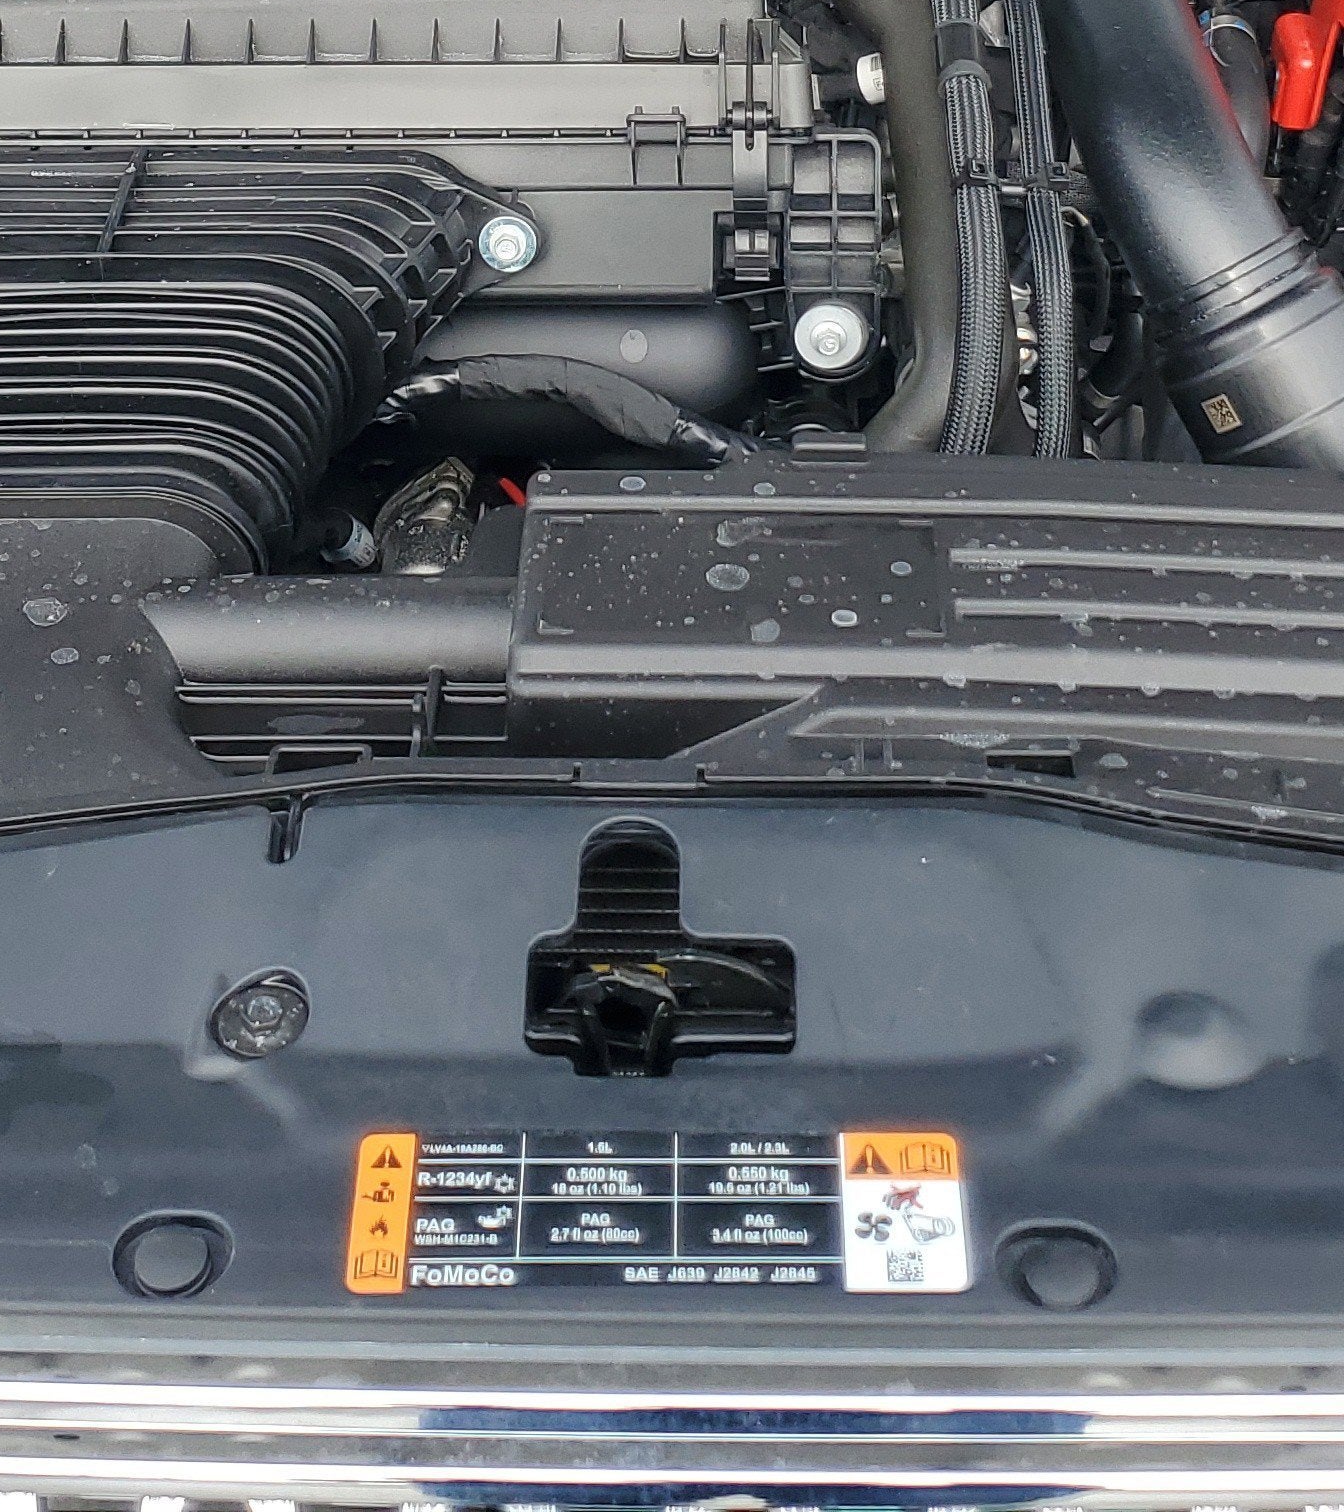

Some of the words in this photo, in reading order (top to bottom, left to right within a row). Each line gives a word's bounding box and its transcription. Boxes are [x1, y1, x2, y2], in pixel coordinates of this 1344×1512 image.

[418, 1171, 493, 1189] R-1234yf
[566, 1167, 605, 1182] 0.500
[609, 1167, 628, 1183] kg
[771, 1166, 789, 1183] kg
[569, 1185, 584, 1195] oz
[736, 1184, 752, 1194] oz
[416, 1218, 455, 1233] PAG
[745, 1214, 775, 1227] PAG
[550, 1227, 569, 1242] 2.7
[584, 1230, 599, 1242] oz
[712, 1228, 731, 1243] 3.4
[745, 1231, 760, 1243] oz
[411, 1264, 516, 1286] FoMoCo
[624, 1266, 659, 1282] SAE
